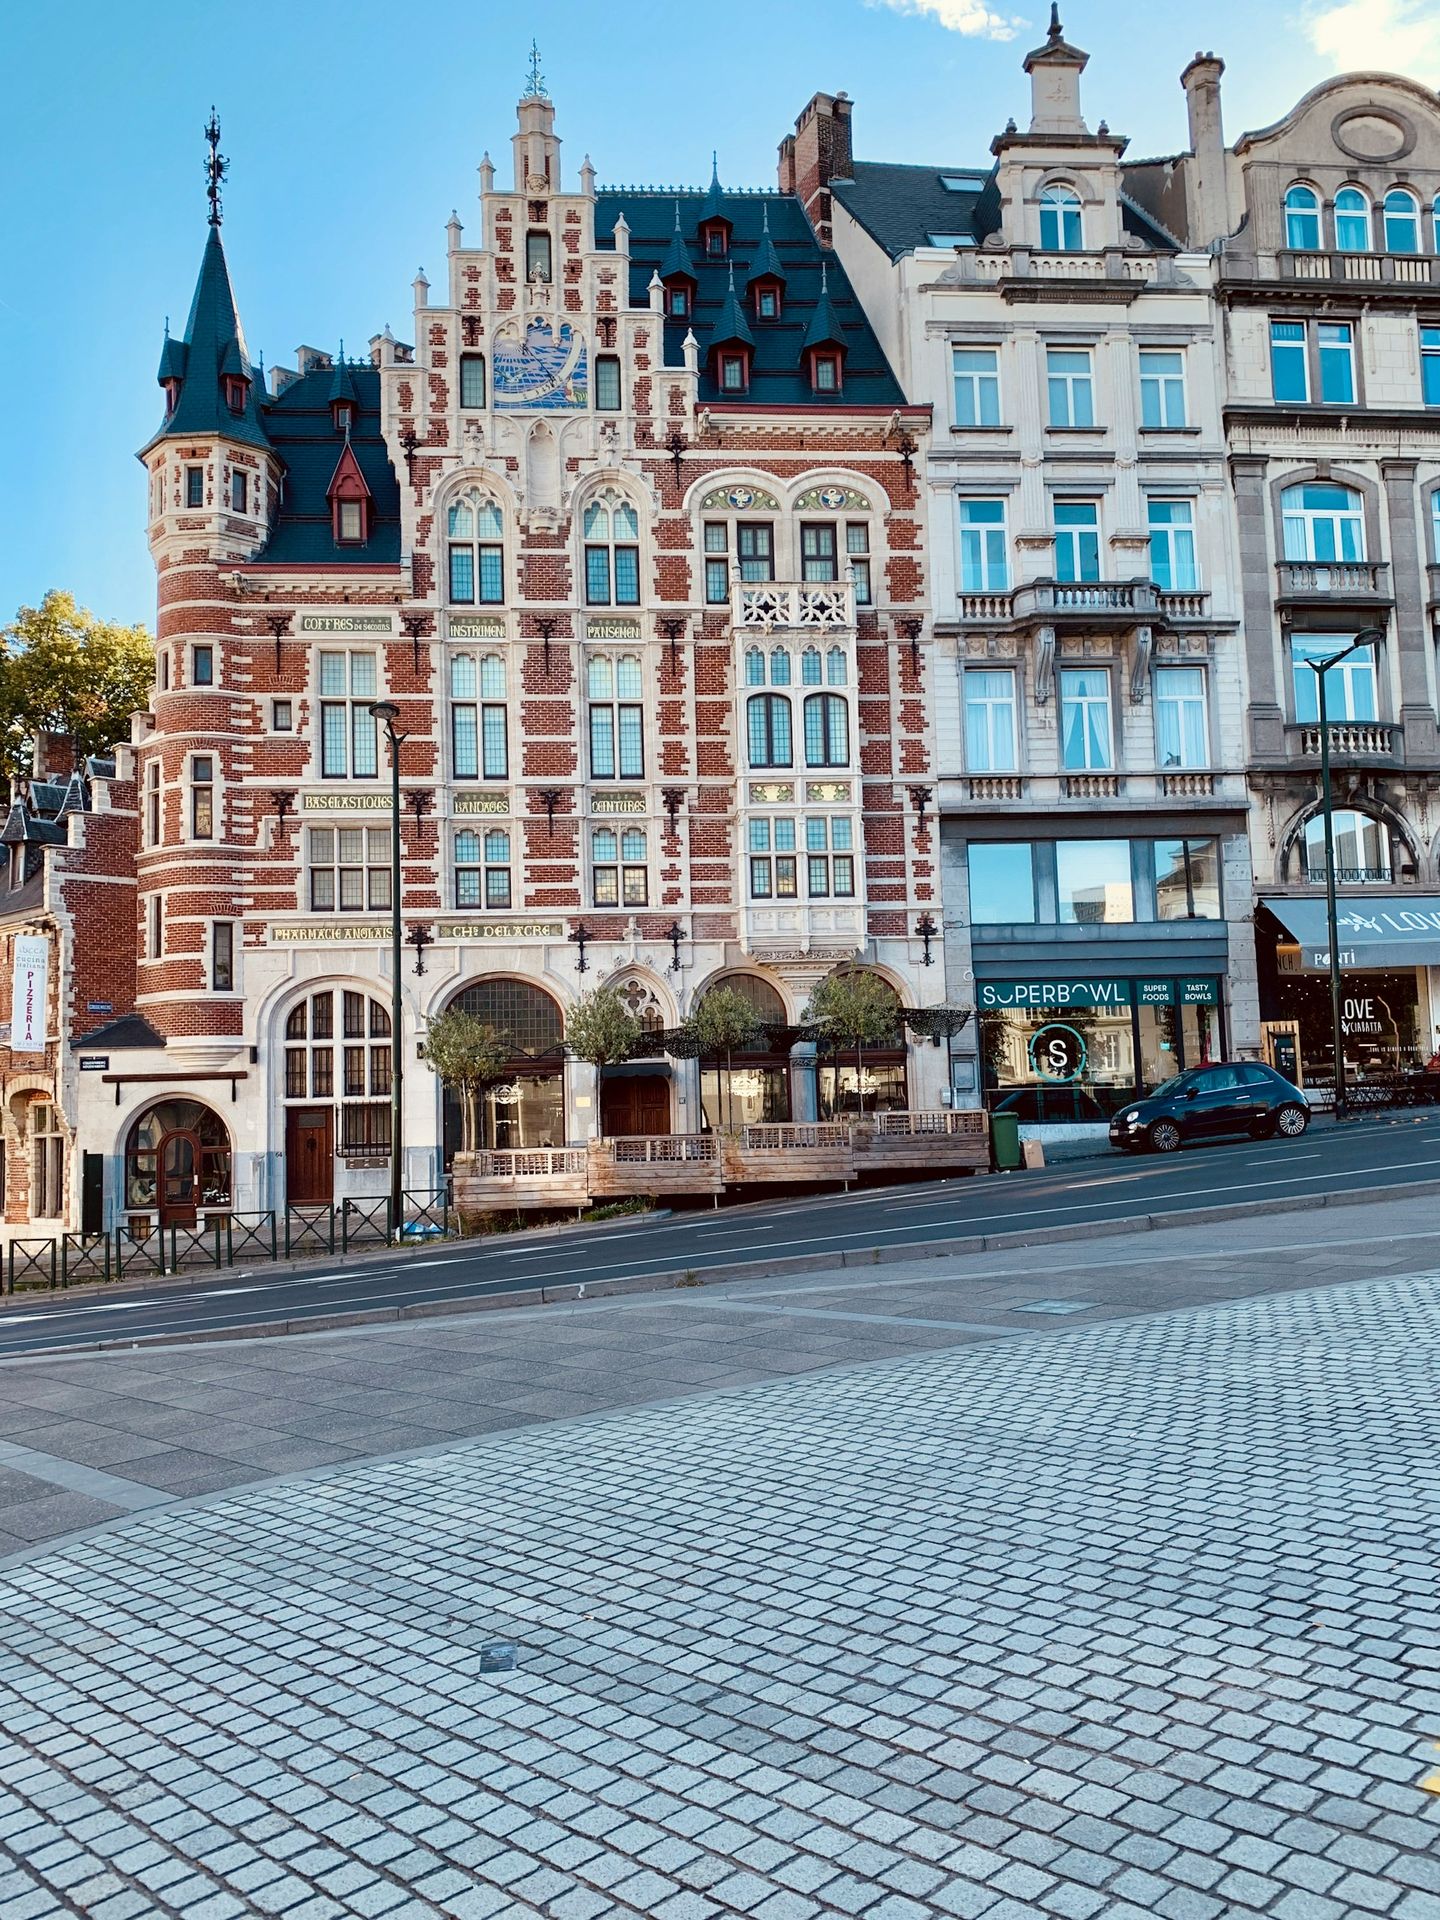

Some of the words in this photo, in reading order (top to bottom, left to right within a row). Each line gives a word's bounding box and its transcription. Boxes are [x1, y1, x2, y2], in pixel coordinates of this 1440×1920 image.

[304, 617, 353, 631] COFFRES
[455, 801, 508, 813] BANDAGES
[1381, 911, 1440, 931] LOV
[274, 928, 341, 940] PHARMACIE
[344, 927, 394, 939] ANGLAIS
[483, 925, 550, 937] DELACRE
[983, 983, 1125, 1004] SUPERBOWL
[1143, 984, 1167, 992] SUPER
[1142, 993, 1169, 1001] FOODS
[1184, 992, 1212, 1000] BOWLS
[25, 971, 34, 1041] PIZZERIA
[1341, 998, 1375, 1020] OVE
[1049, 1039, 1068, 1067] S
